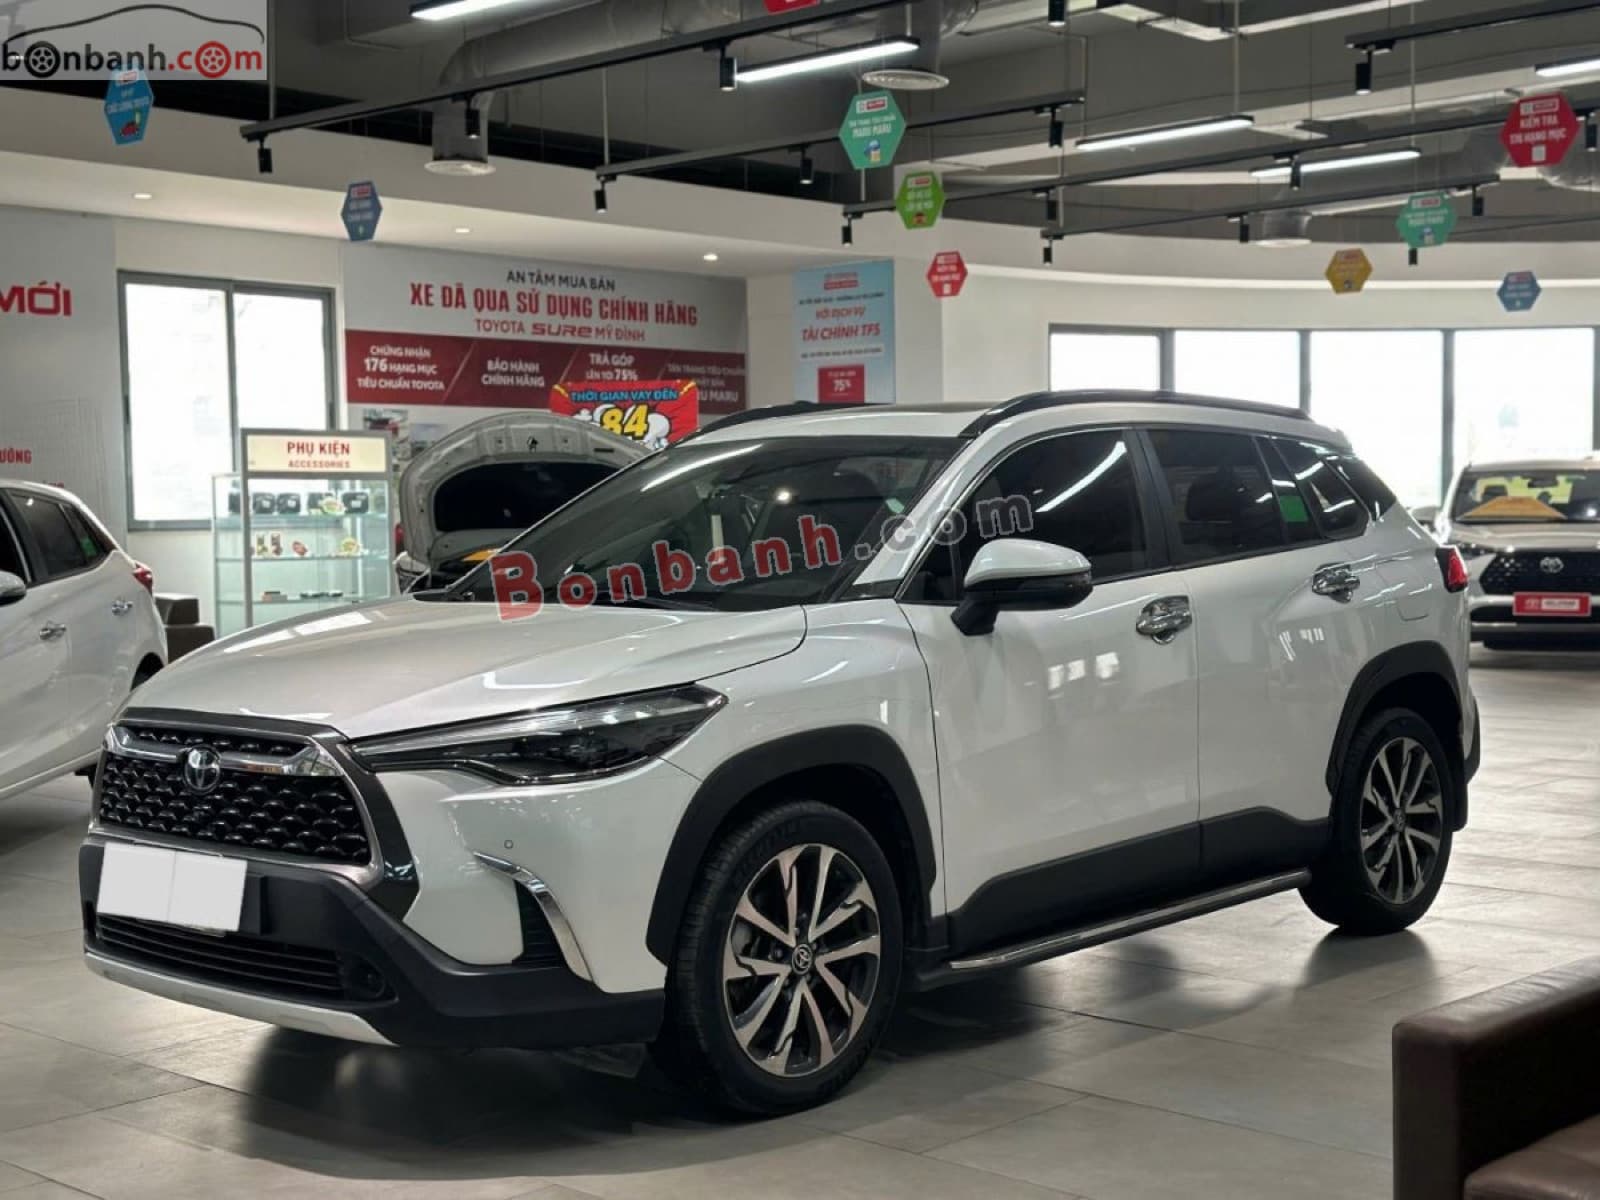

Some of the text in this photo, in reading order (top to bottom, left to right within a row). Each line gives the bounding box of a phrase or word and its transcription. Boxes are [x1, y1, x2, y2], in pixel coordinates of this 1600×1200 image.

[507, 271, 525, 283] AN
[527, 269, 556, 288] TÂM
[558, 274, 588, 289] MUA
[410, 282, 435, 307] XE
[441, 282, 467, 309] ĐÃ
[473, 288, 511, 313] QUA
[516, 288, 541, 315] SỬ
[547, 294, 593, 320] DỤNG
[599, 296, 649, 323] CHÍNH
[475, 319, 526, 334] TOYOTA
[364, 358, 388, 372] 176
[611, 352, 635, 366] GÓP
[614, 368, 638, 381] 75%
[411, 380, 446, 391] TOYOTA
[571, 386, 679, 402] THỜI GIAN VAY ĐẾN
[287, 441, 351, 459] PHỤ KIỆN
[288, 460, 351, 469] ACCESSORIES
